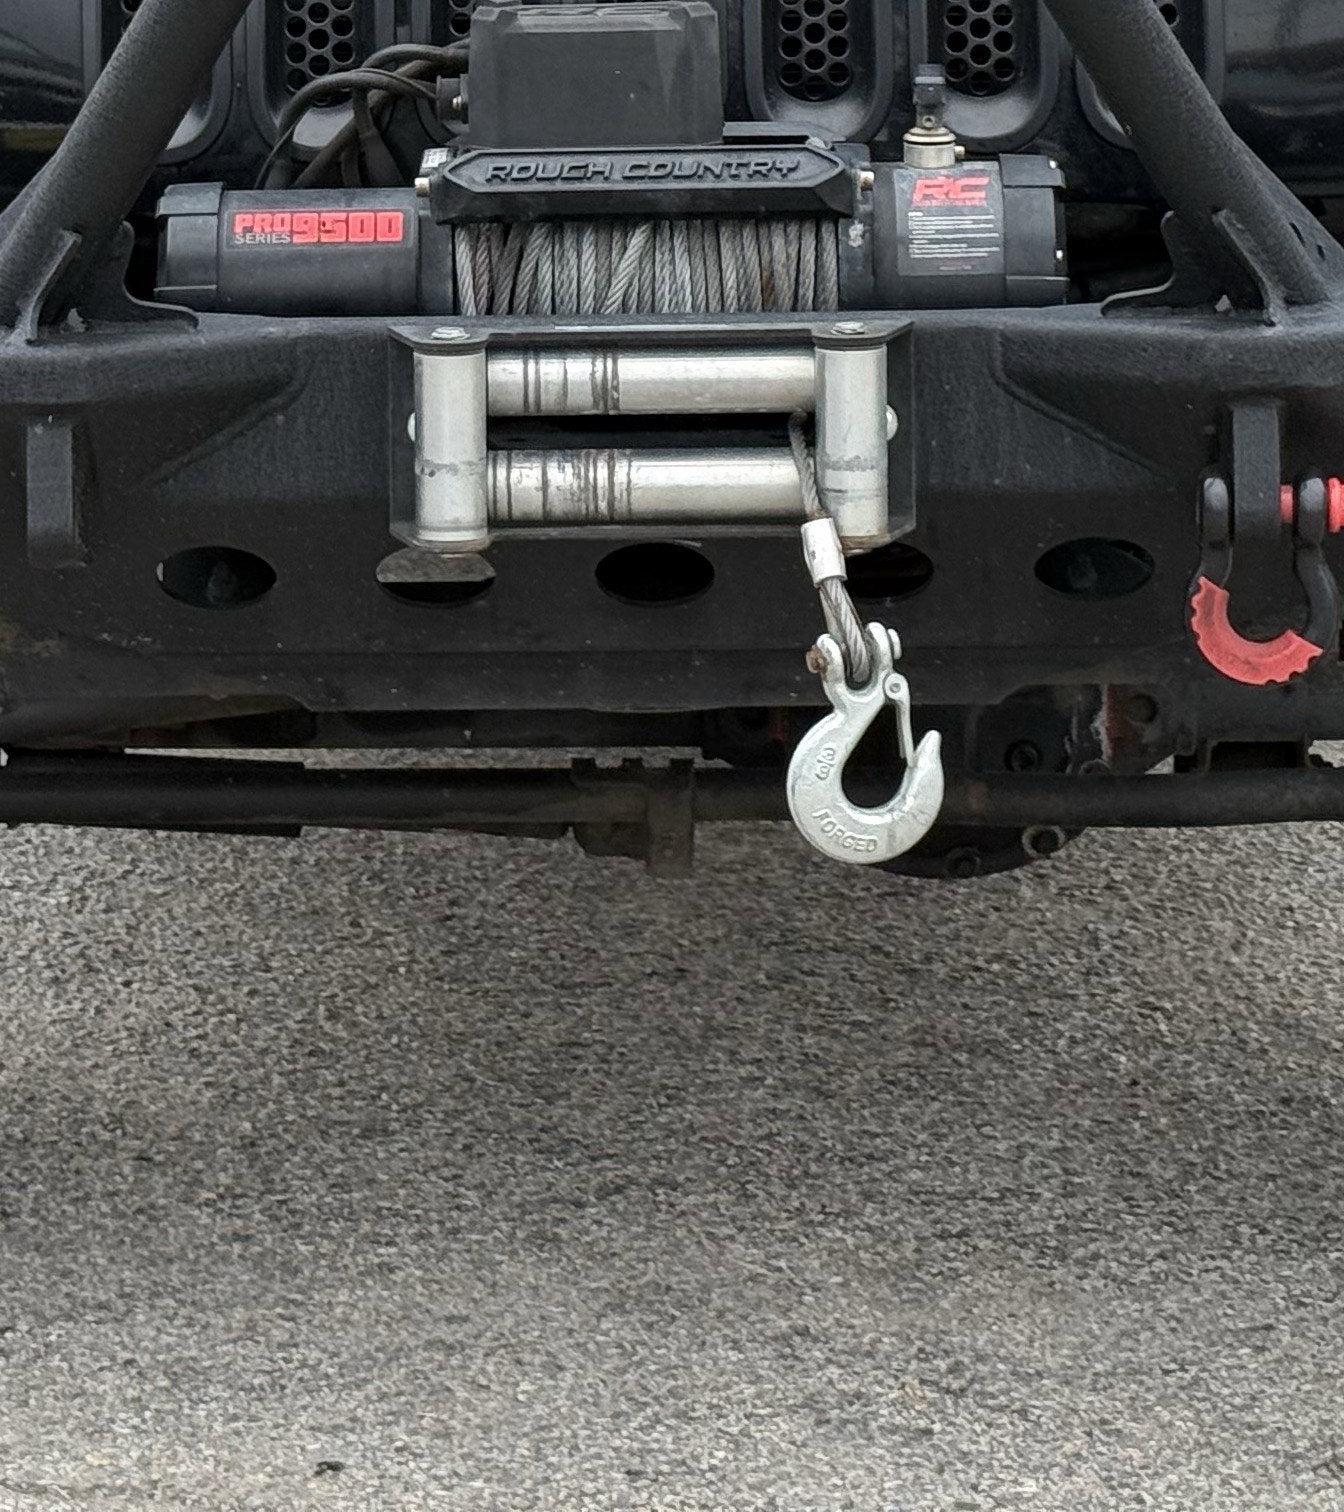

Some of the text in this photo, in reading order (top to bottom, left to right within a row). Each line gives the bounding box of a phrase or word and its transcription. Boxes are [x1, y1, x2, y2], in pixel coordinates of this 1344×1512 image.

[485, 158, 802, 184] ROUGH COUNTRY
[912, 176, 990, 202] RC
[233, 211, 404, 244] PRO 9500
[234, 232, 291, 245] SERIES
[812, 807, 879, 853] FORGED
